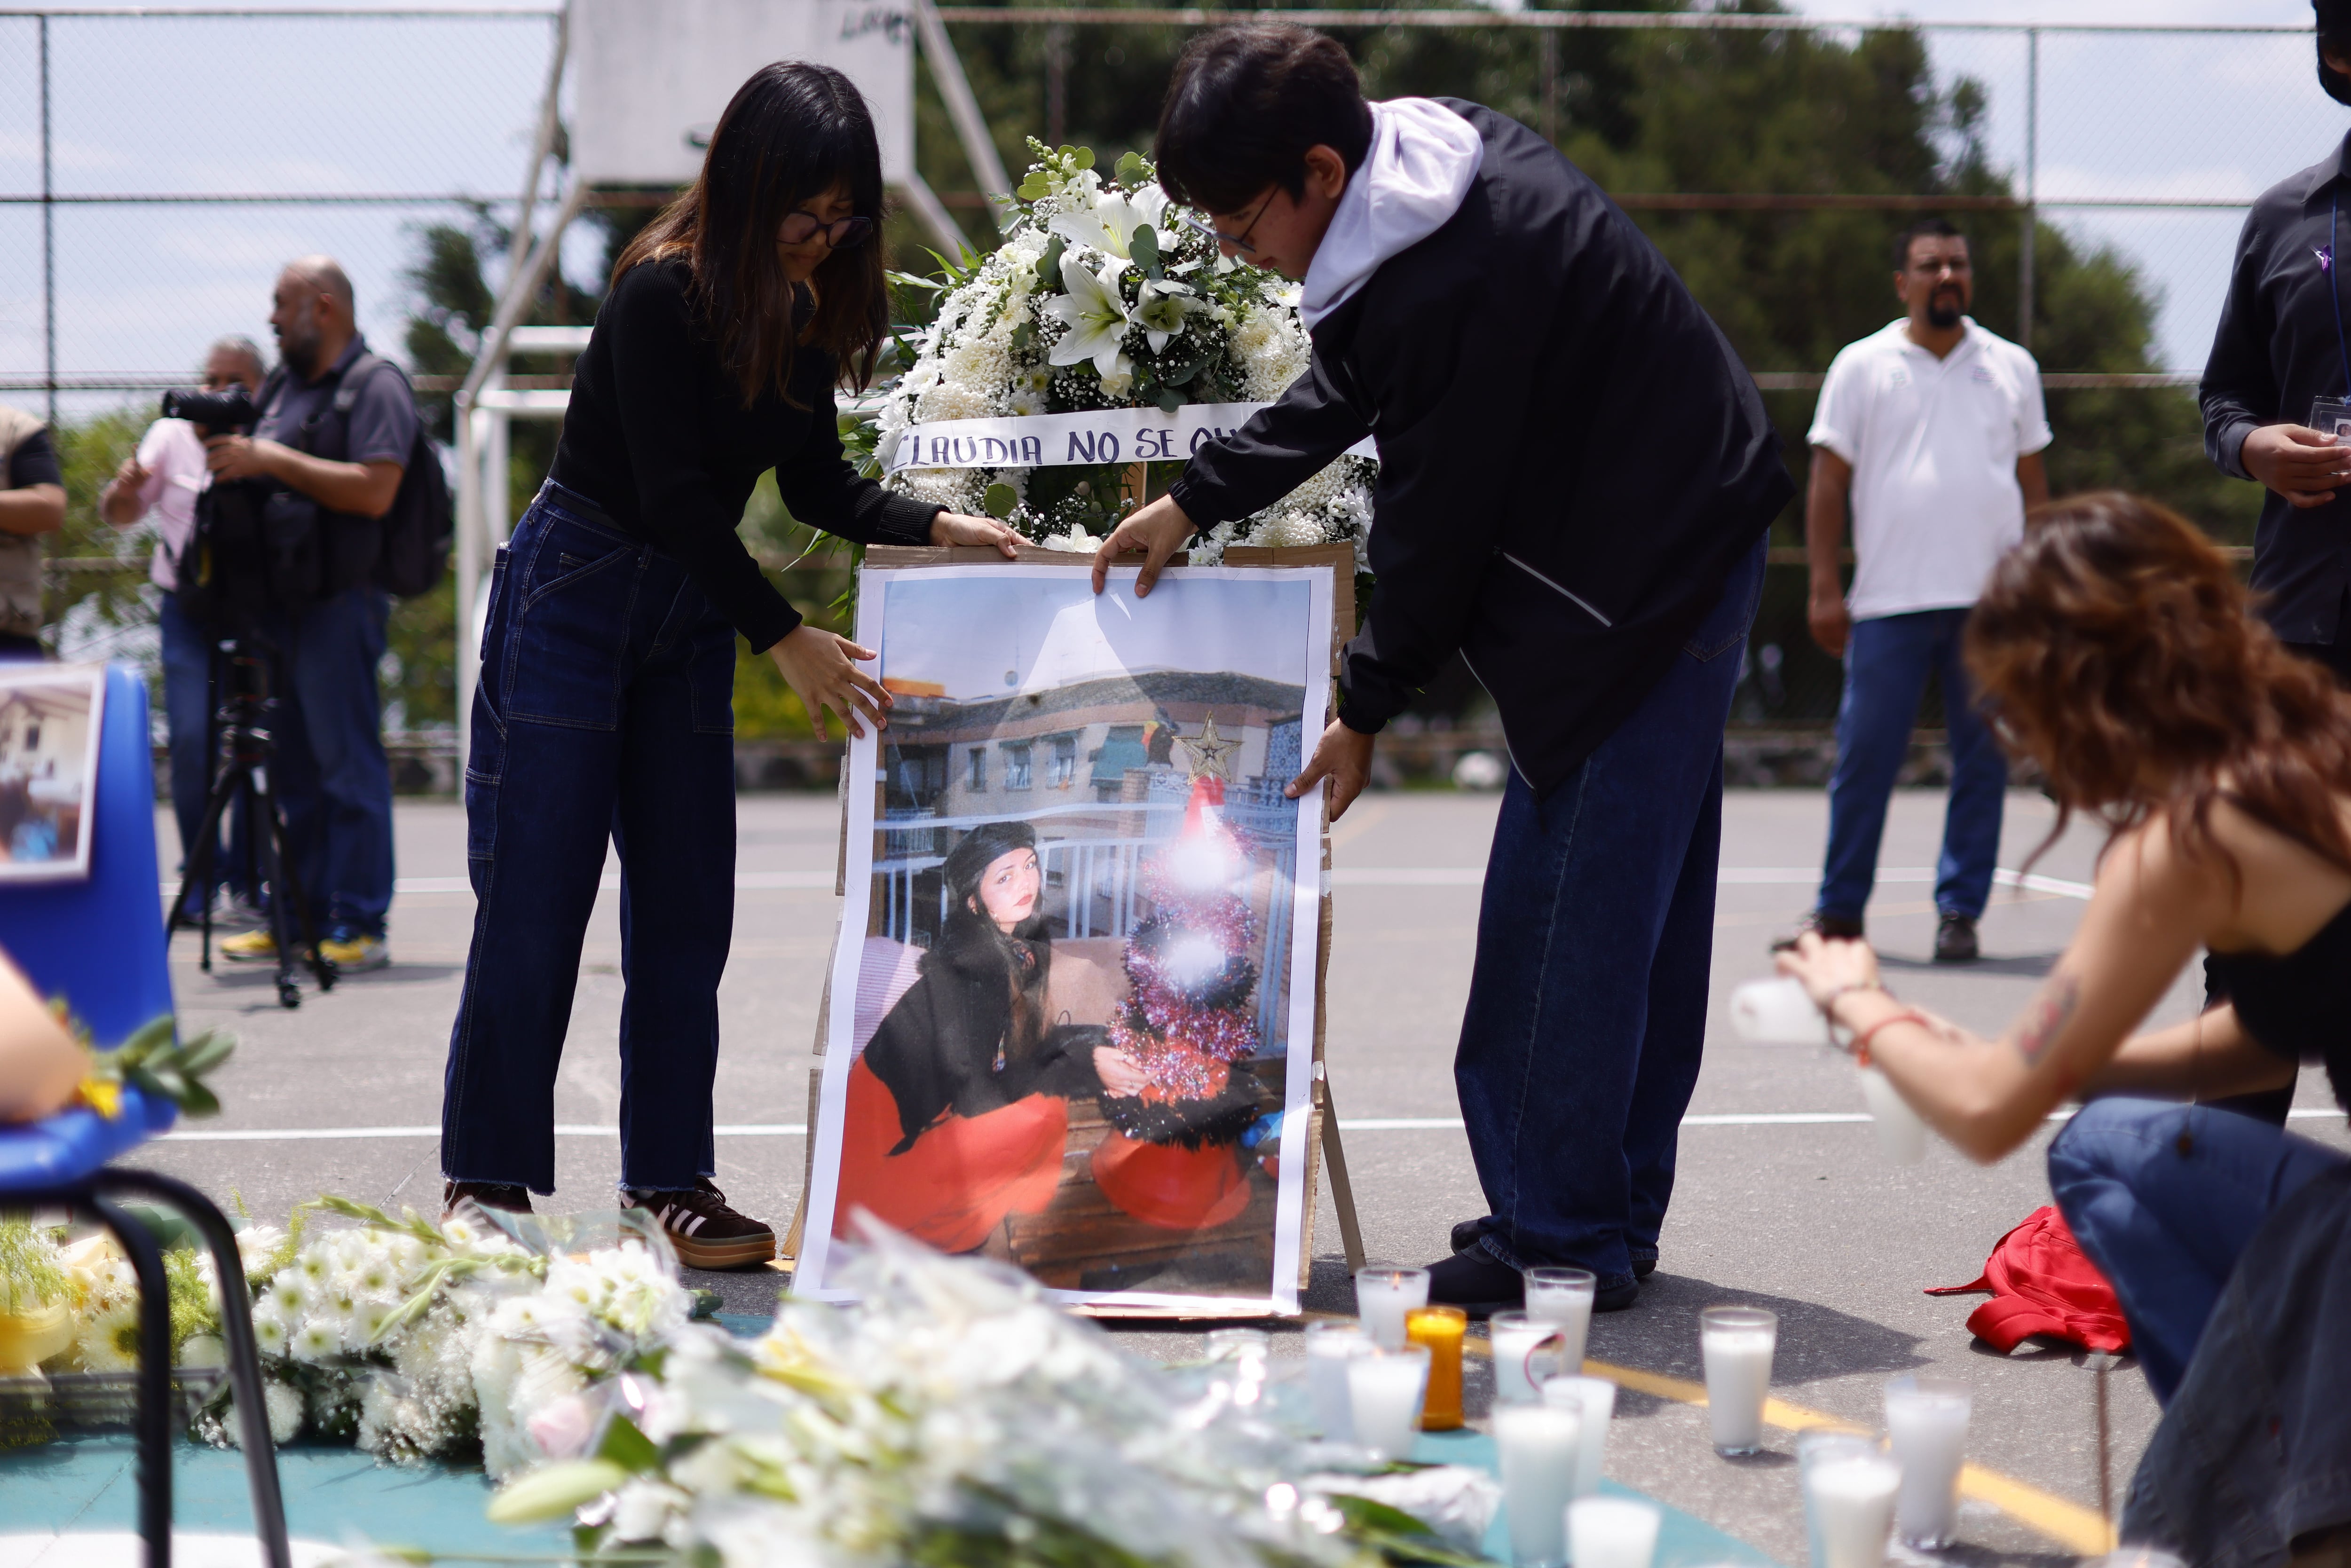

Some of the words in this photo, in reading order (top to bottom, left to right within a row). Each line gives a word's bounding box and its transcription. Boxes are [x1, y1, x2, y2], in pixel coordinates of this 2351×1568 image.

[891, 434, 1042, 470] CLAUDIA
[1067, 430, 1120, 463] NO
[1135, 428, 1178, 458] SE
